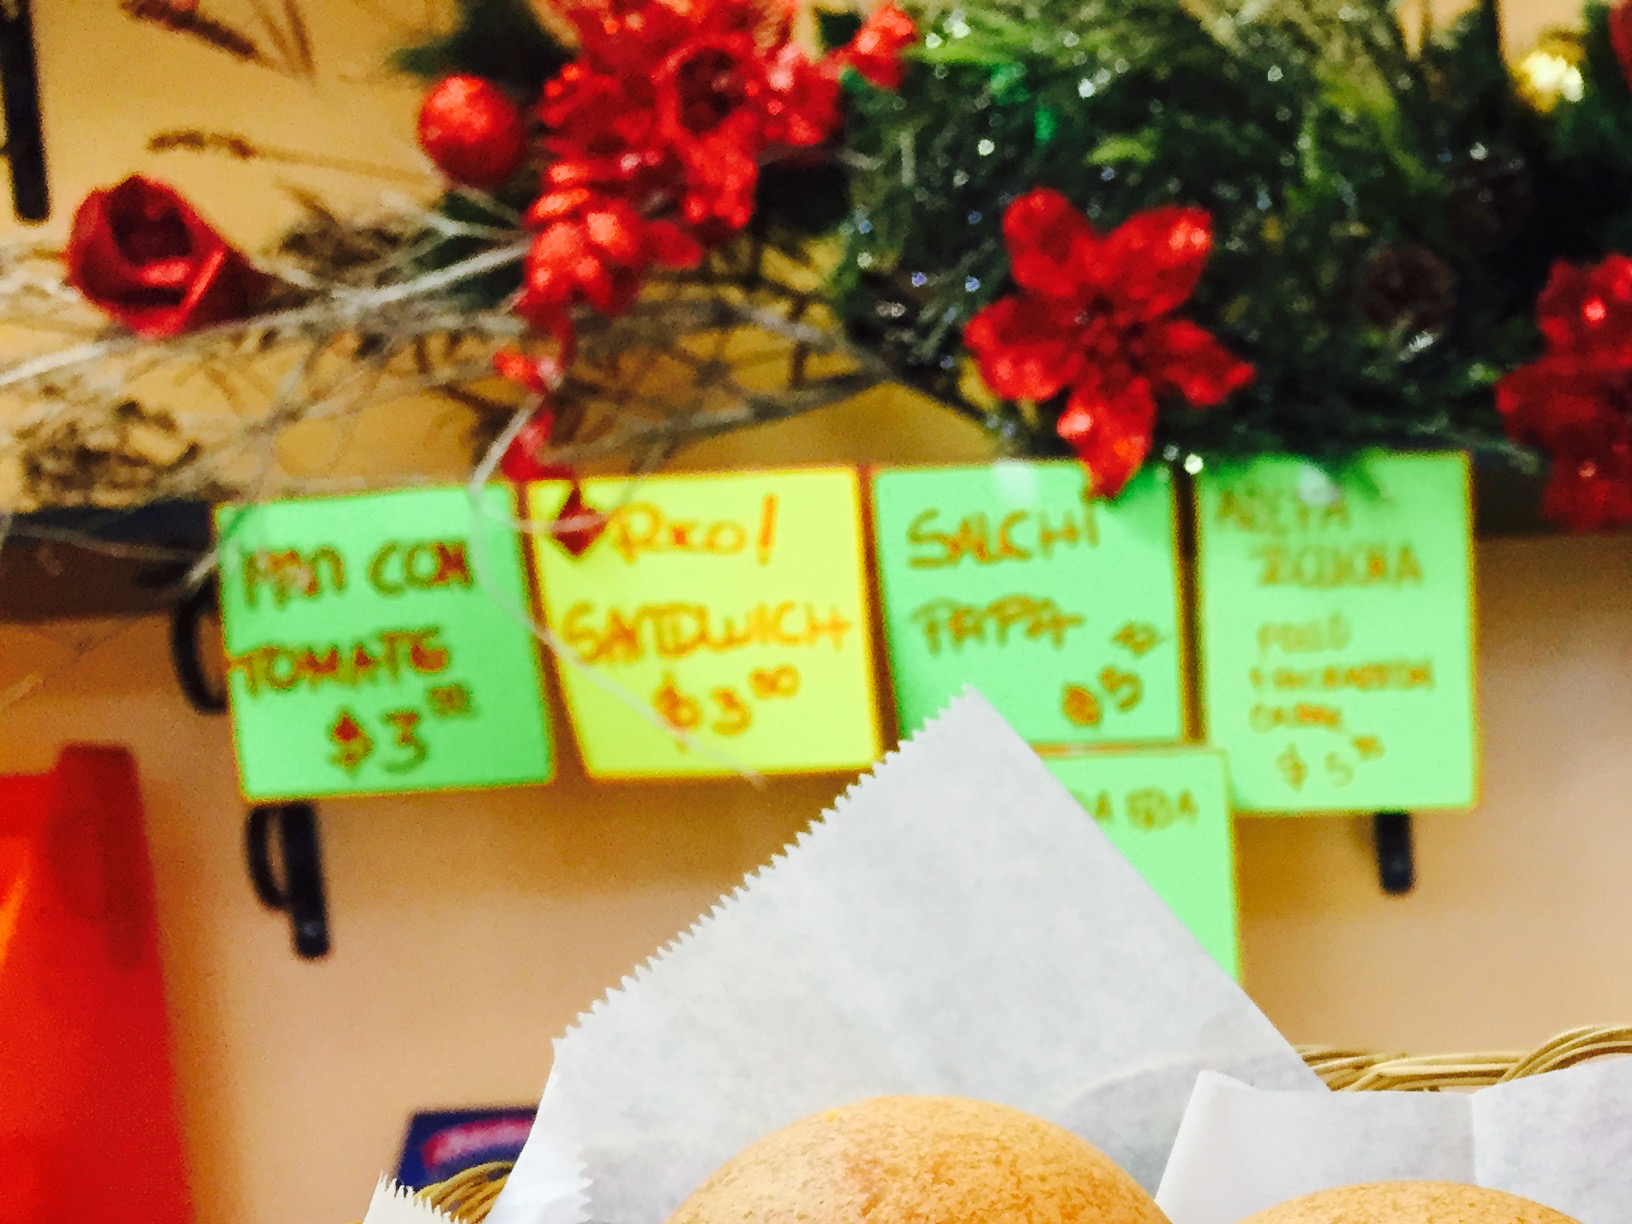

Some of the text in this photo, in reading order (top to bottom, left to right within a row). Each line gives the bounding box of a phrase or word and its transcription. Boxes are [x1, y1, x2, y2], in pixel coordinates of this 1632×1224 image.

[369, 539, 474, 598] CON
[907, 506, 1101, 570] SALCHI
[562, 600, 851, 668] SANDWICH
[911, 594, 1085, 657] PAPA
[231, 628, 452, 699] TOMATE
